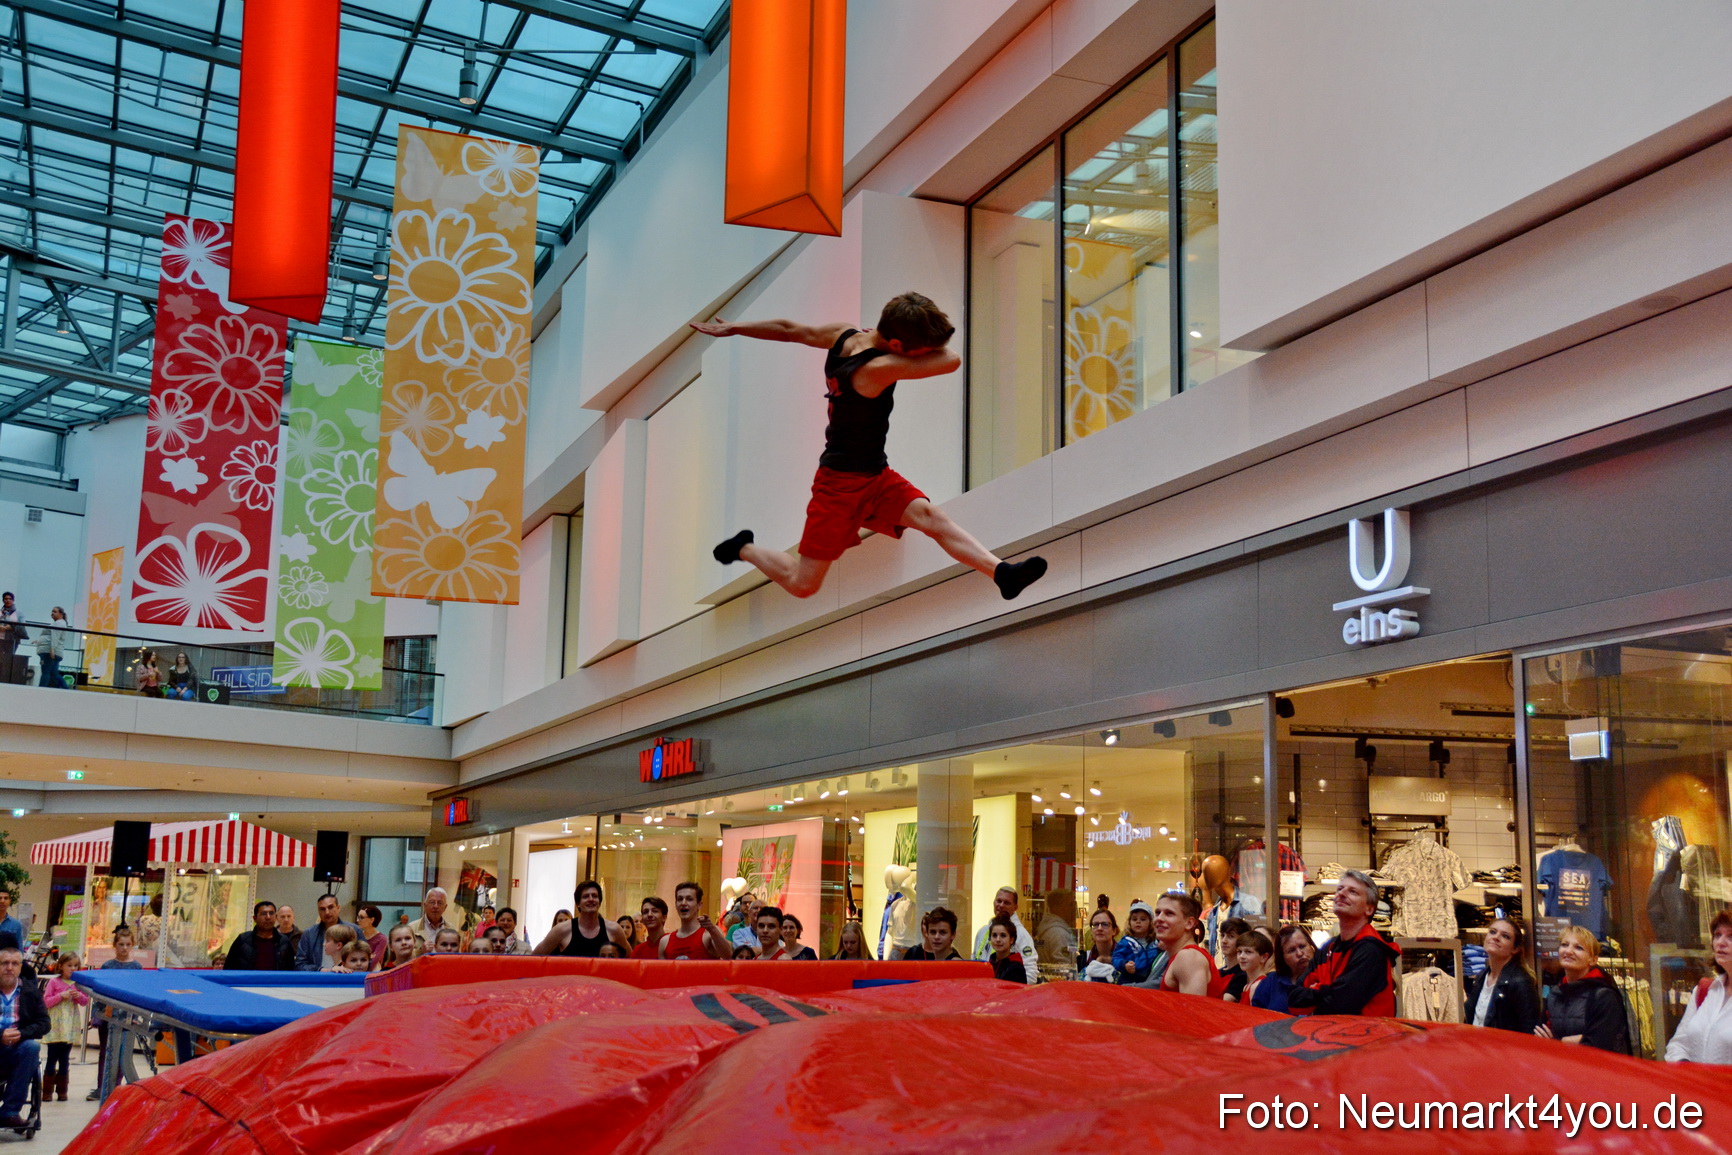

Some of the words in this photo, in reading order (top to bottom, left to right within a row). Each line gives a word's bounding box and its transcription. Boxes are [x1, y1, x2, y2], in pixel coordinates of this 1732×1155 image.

[1348, 507, 1405, 592] U
[1342, 605, 1412, 645] eins
[216, 672, 273, 689] HILLSID
[639, 736, 697, 783] WÖHRL
[1563, 871, 1586, 885] SEA
[1020, 912, 1044, 922] PIECES
